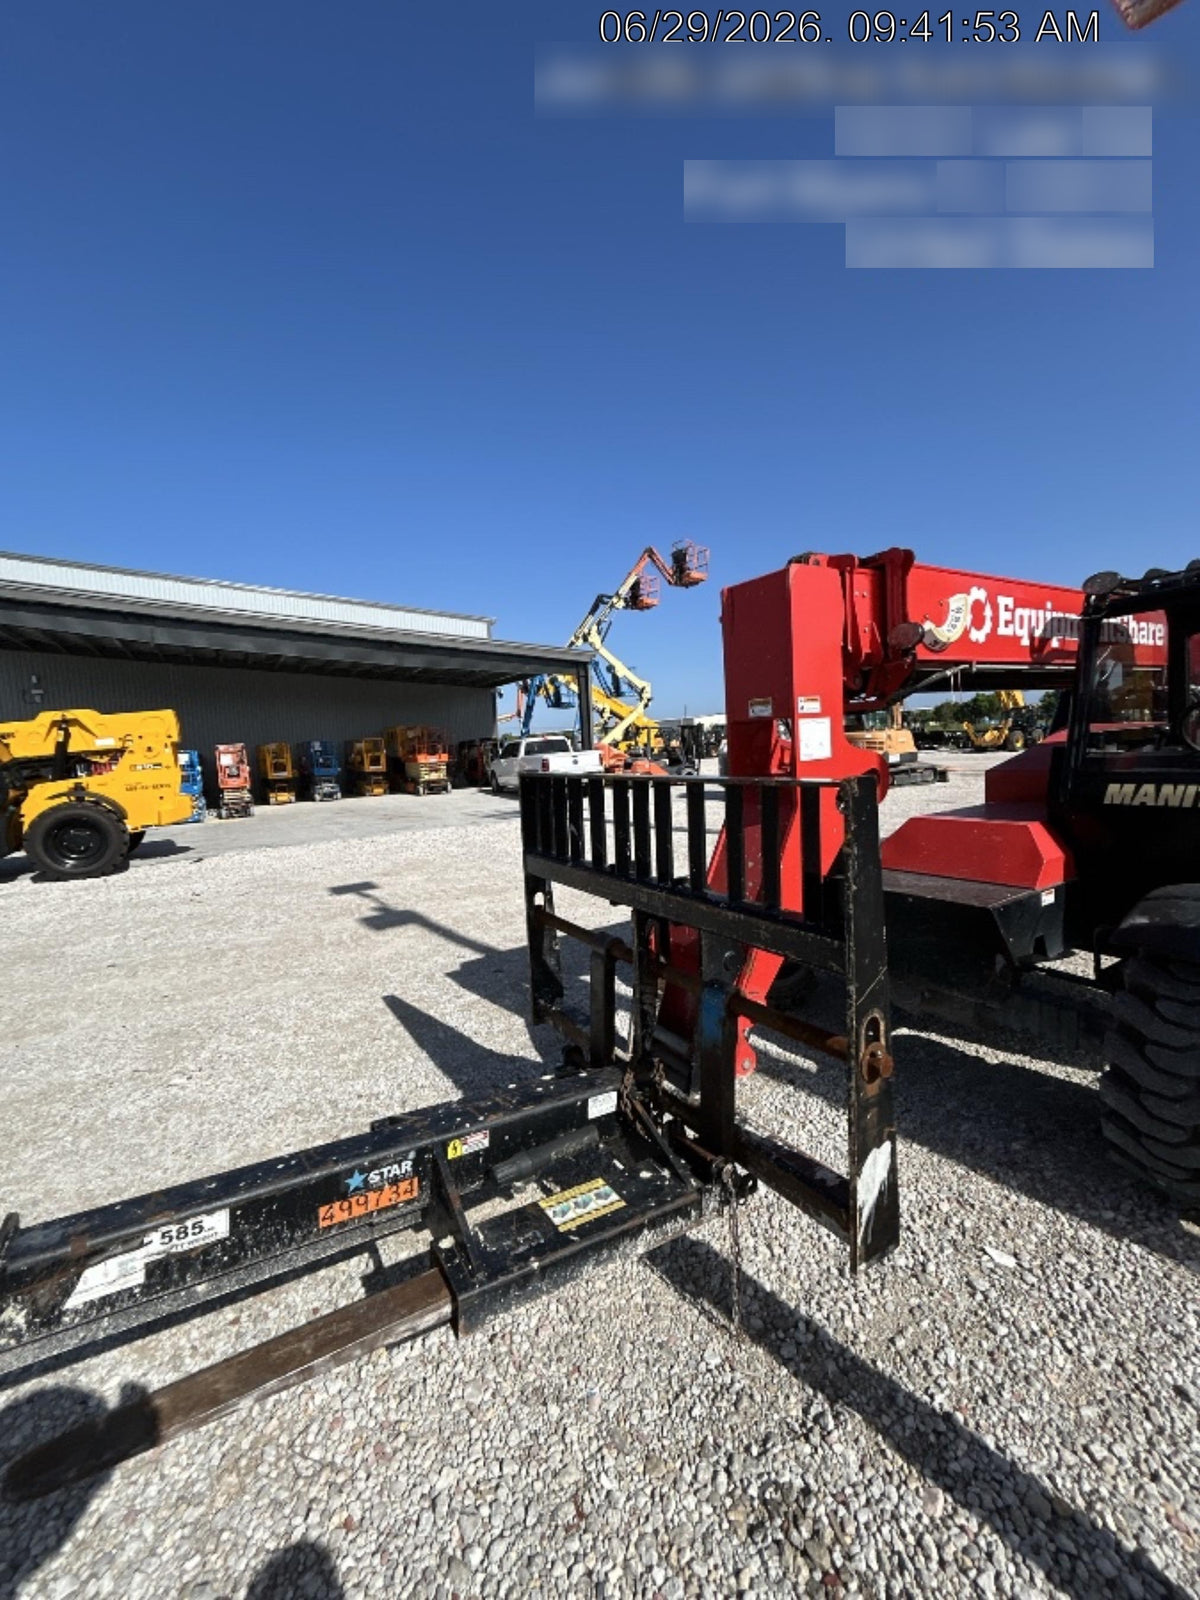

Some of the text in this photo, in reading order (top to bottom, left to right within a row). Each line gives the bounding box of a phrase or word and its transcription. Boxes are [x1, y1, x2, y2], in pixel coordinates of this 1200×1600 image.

[1103, 783, 1200, 808] MANI
[367, 1160, 413, 1184] STAR
[160, 1220, 204, 1245] 585
